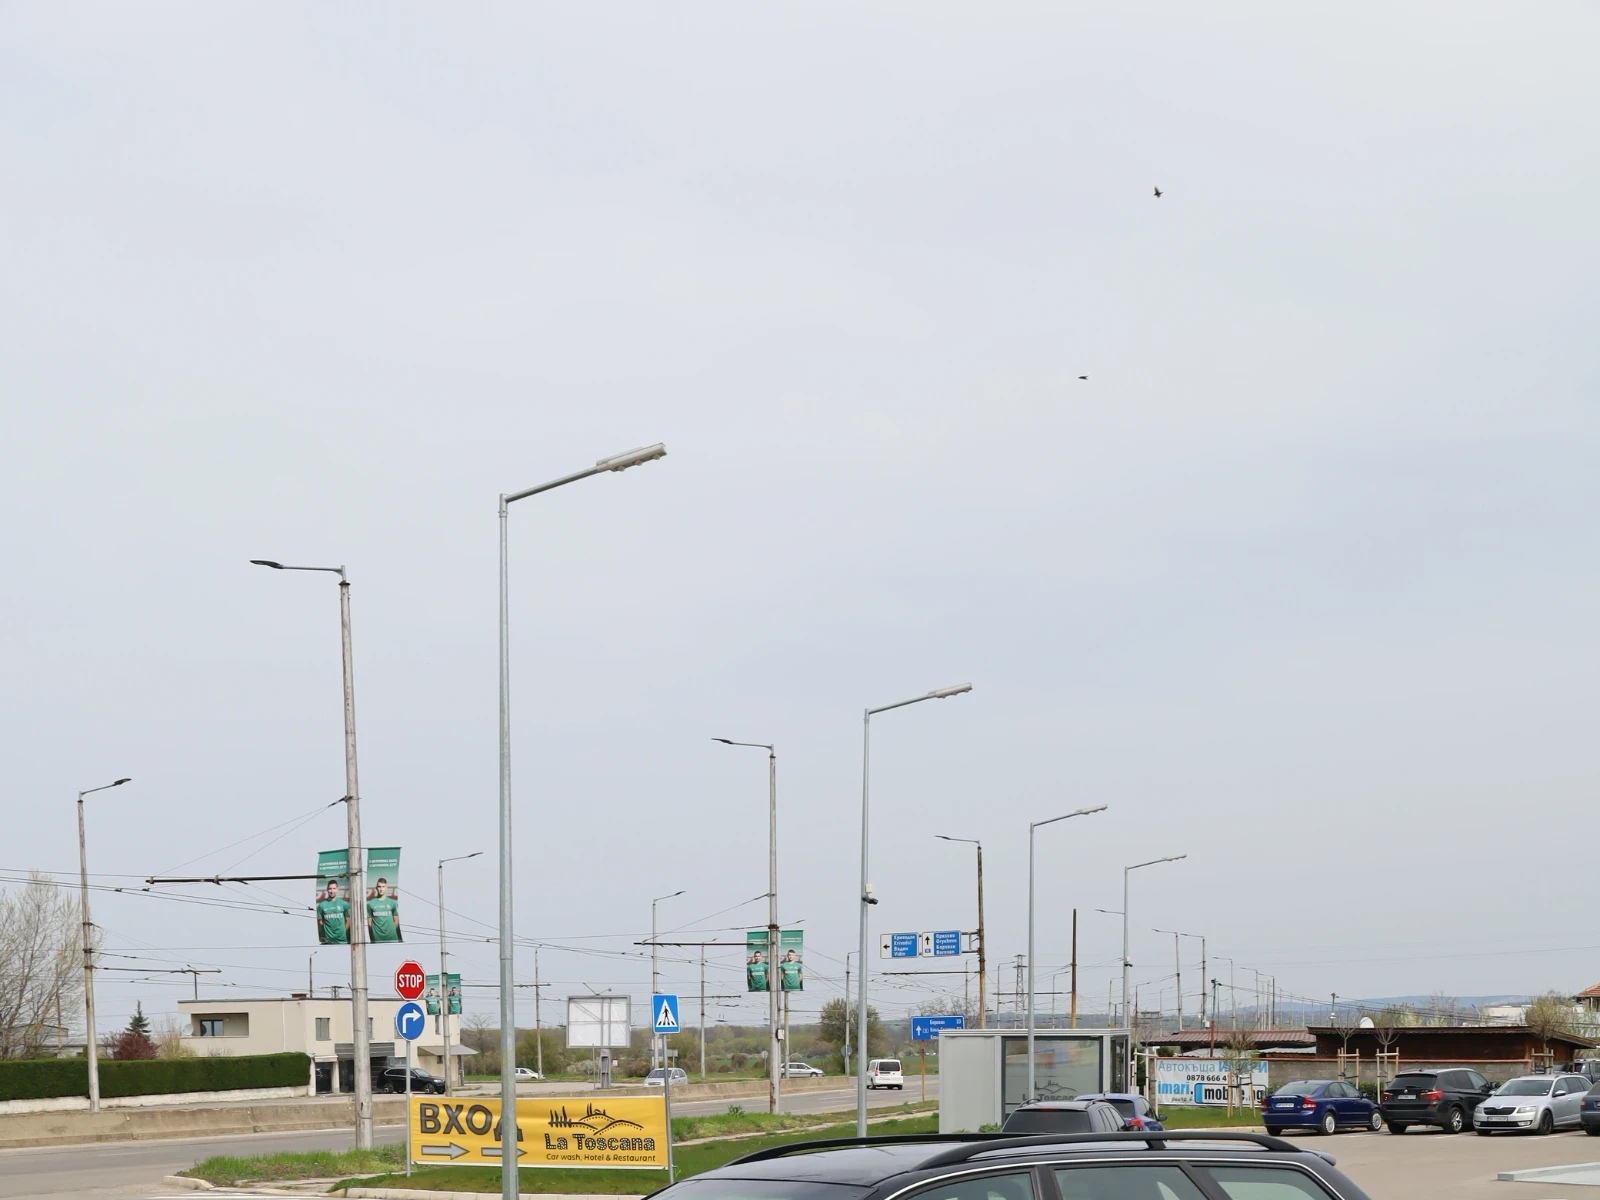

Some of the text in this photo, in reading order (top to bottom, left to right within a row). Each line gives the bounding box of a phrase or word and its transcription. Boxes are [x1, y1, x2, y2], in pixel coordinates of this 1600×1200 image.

[398, 974, 423, 989] STOP
[1158, 1060, 1215, 1073] Автокъща
[1186, 1074, 1205, 1082] 0878
[1206, 1074, 1221, 1082] 666
[544, 1133, 656, 1151] La Toscana
[546, 1153, 656, 1162] Car wash, Hotel & Restaurant
